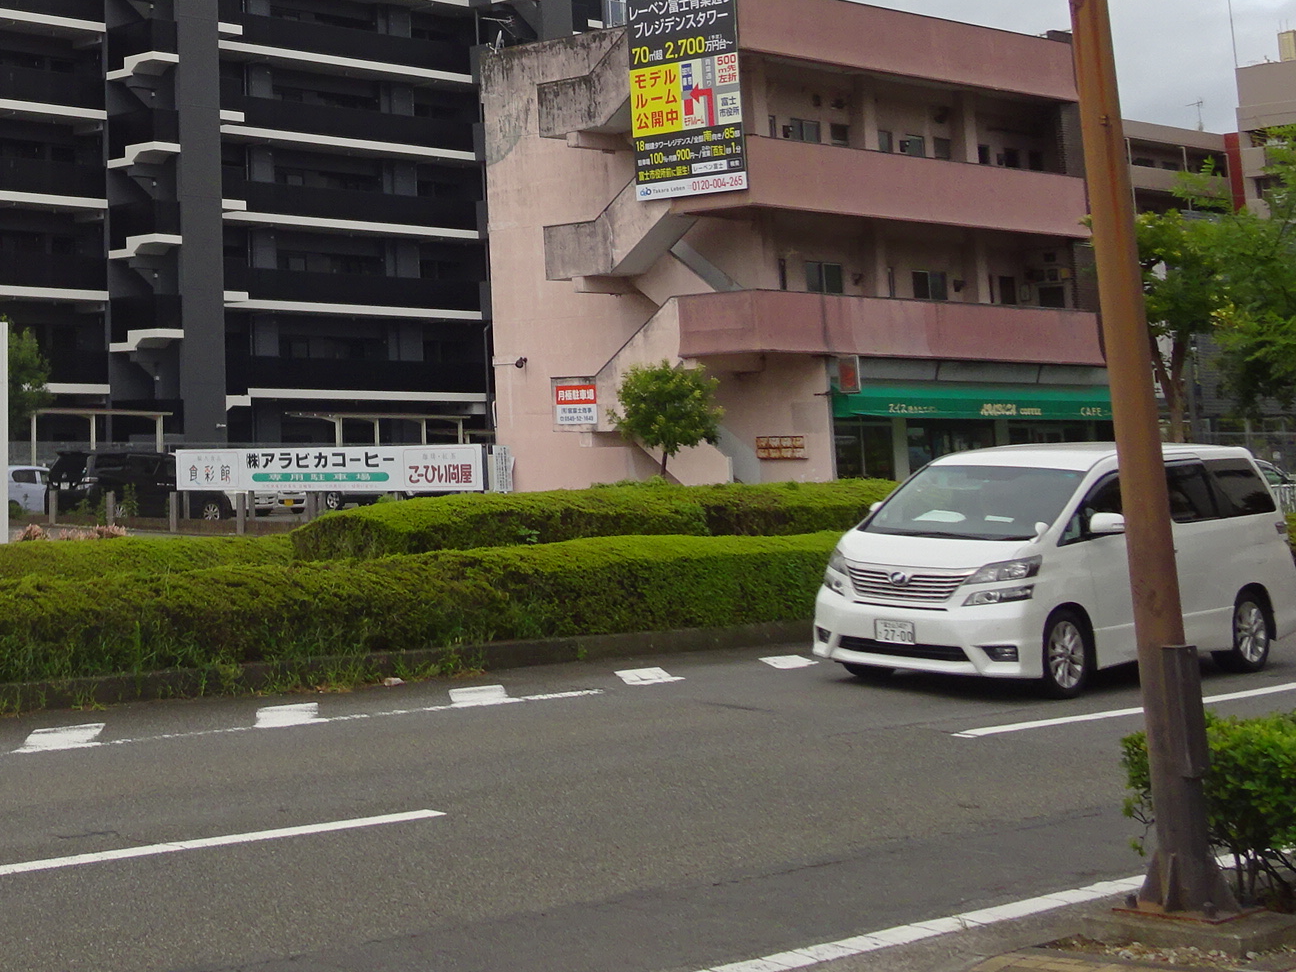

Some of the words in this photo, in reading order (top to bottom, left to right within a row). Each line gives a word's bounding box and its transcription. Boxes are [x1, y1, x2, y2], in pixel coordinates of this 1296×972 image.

[717, 54, 736, 65] 500
[634, 69, 677, 89] モデル
[718, 72, 737, 83] 左折
[635, 89, 678, 109] ルーム
[721, 96, 737, 107] 富士
[719, 106, 740, 117] 市役所
[636, 108, 679, 130] 公開中
[692, 175, 743, 191] 0120-004-265
[558, 388, 595, 401] 月極駐車場
[1080, 407, 1103, 417] CAFE
[189, 464, 231, 485] 食彩館
[268, 472, 371, 481] 専用駐車場
